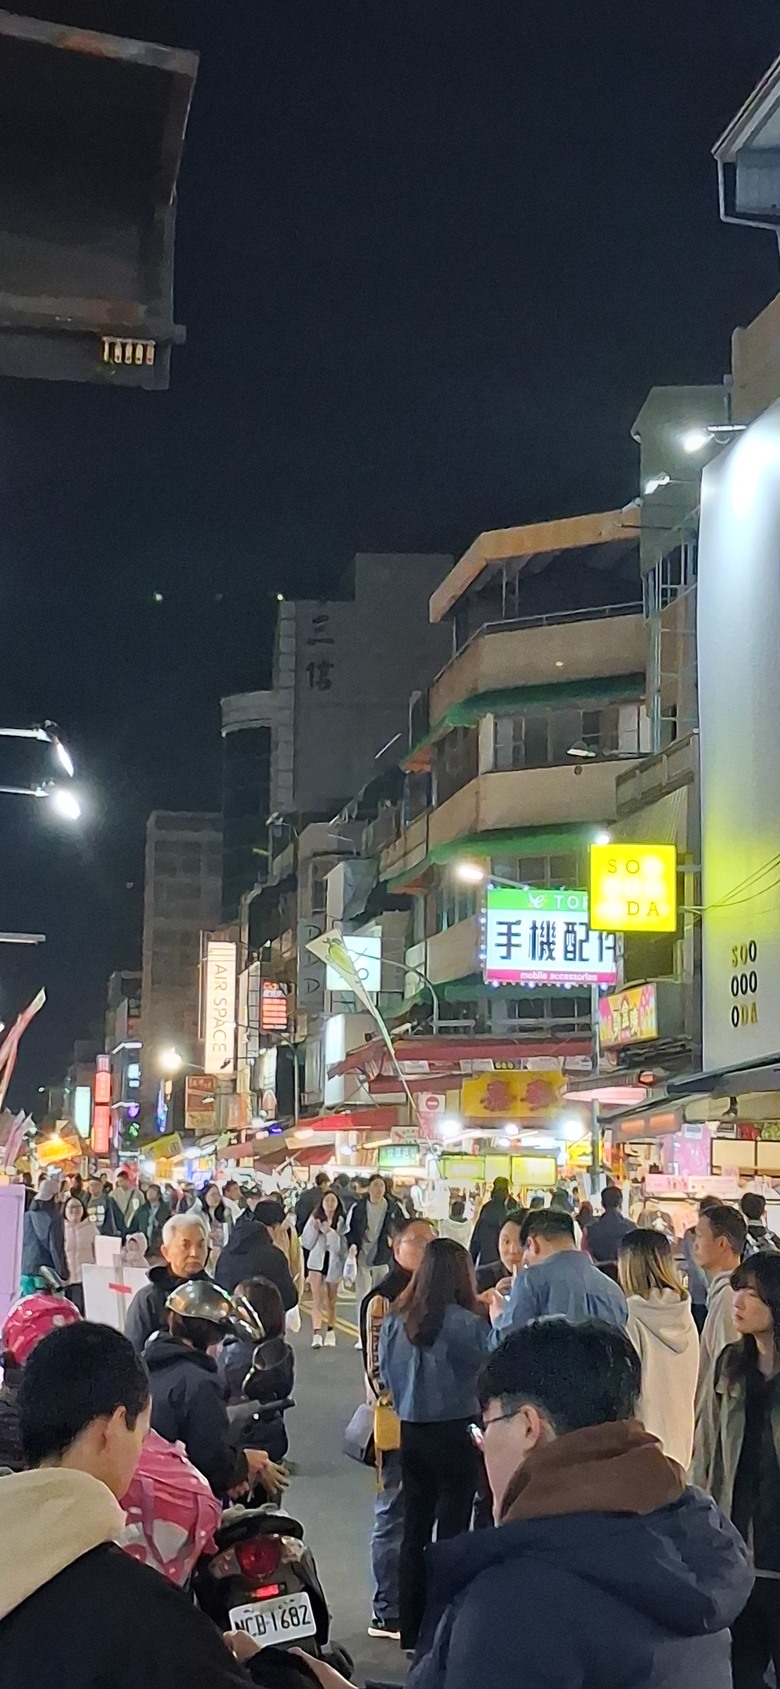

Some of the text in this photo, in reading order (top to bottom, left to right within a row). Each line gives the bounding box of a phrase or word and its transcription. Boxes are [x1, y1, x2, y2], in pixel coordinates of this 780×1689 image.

[520, 971, 598, 982] mobile accessories
[212, 963, 228, 1052] AIR SPACE
